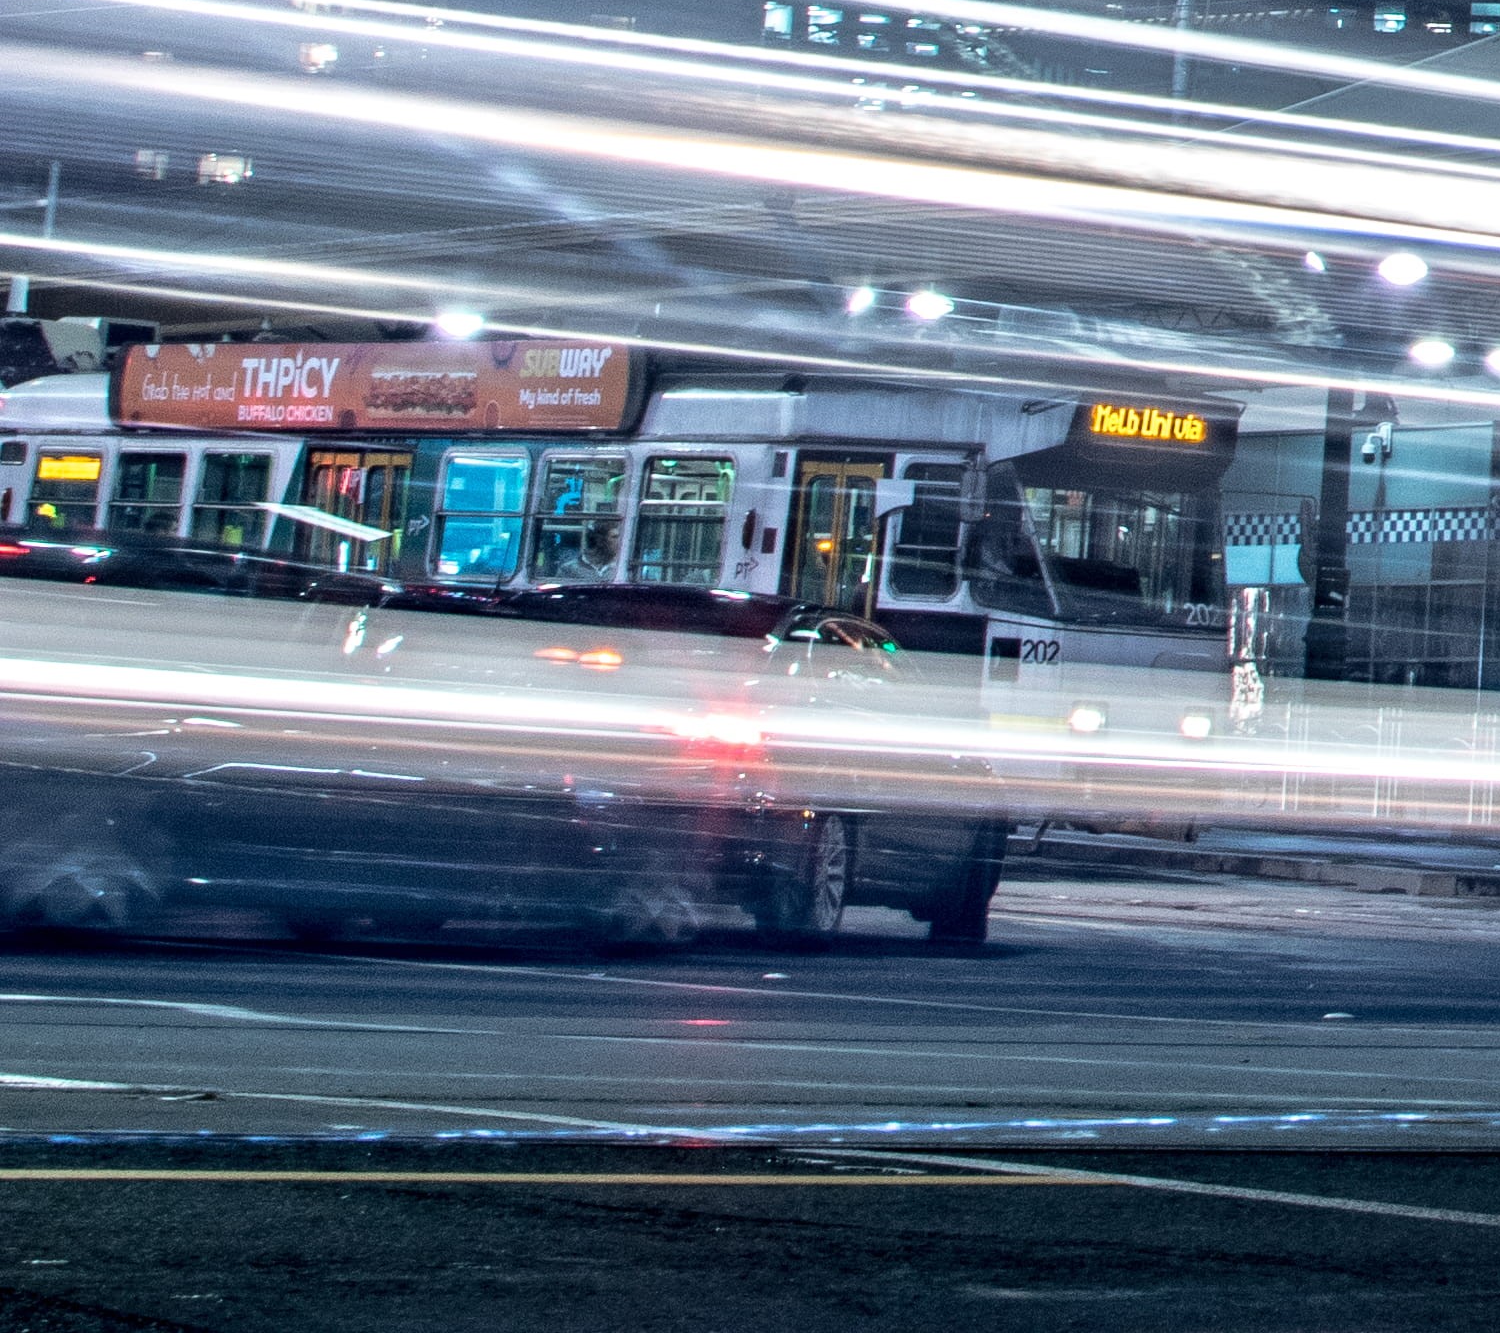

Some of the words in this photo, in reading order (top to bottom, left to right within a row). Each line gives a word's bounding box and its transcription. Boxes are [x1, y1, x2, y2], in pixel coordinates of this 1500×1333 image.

[519, 346, 612, 378] SUBWAY
[519, 388, 536, 410] My
[537, 388, 559, 405] kind
[560, 388, 574, 405] of
[574, 388, 601, 405] fresh
[237, 405, 285, 423] BUFFALO
[286, 405, 334, 422] CHICKEN
[1174, 413, 1205, 441] via
[1022, 639, 1060, 665] 202
